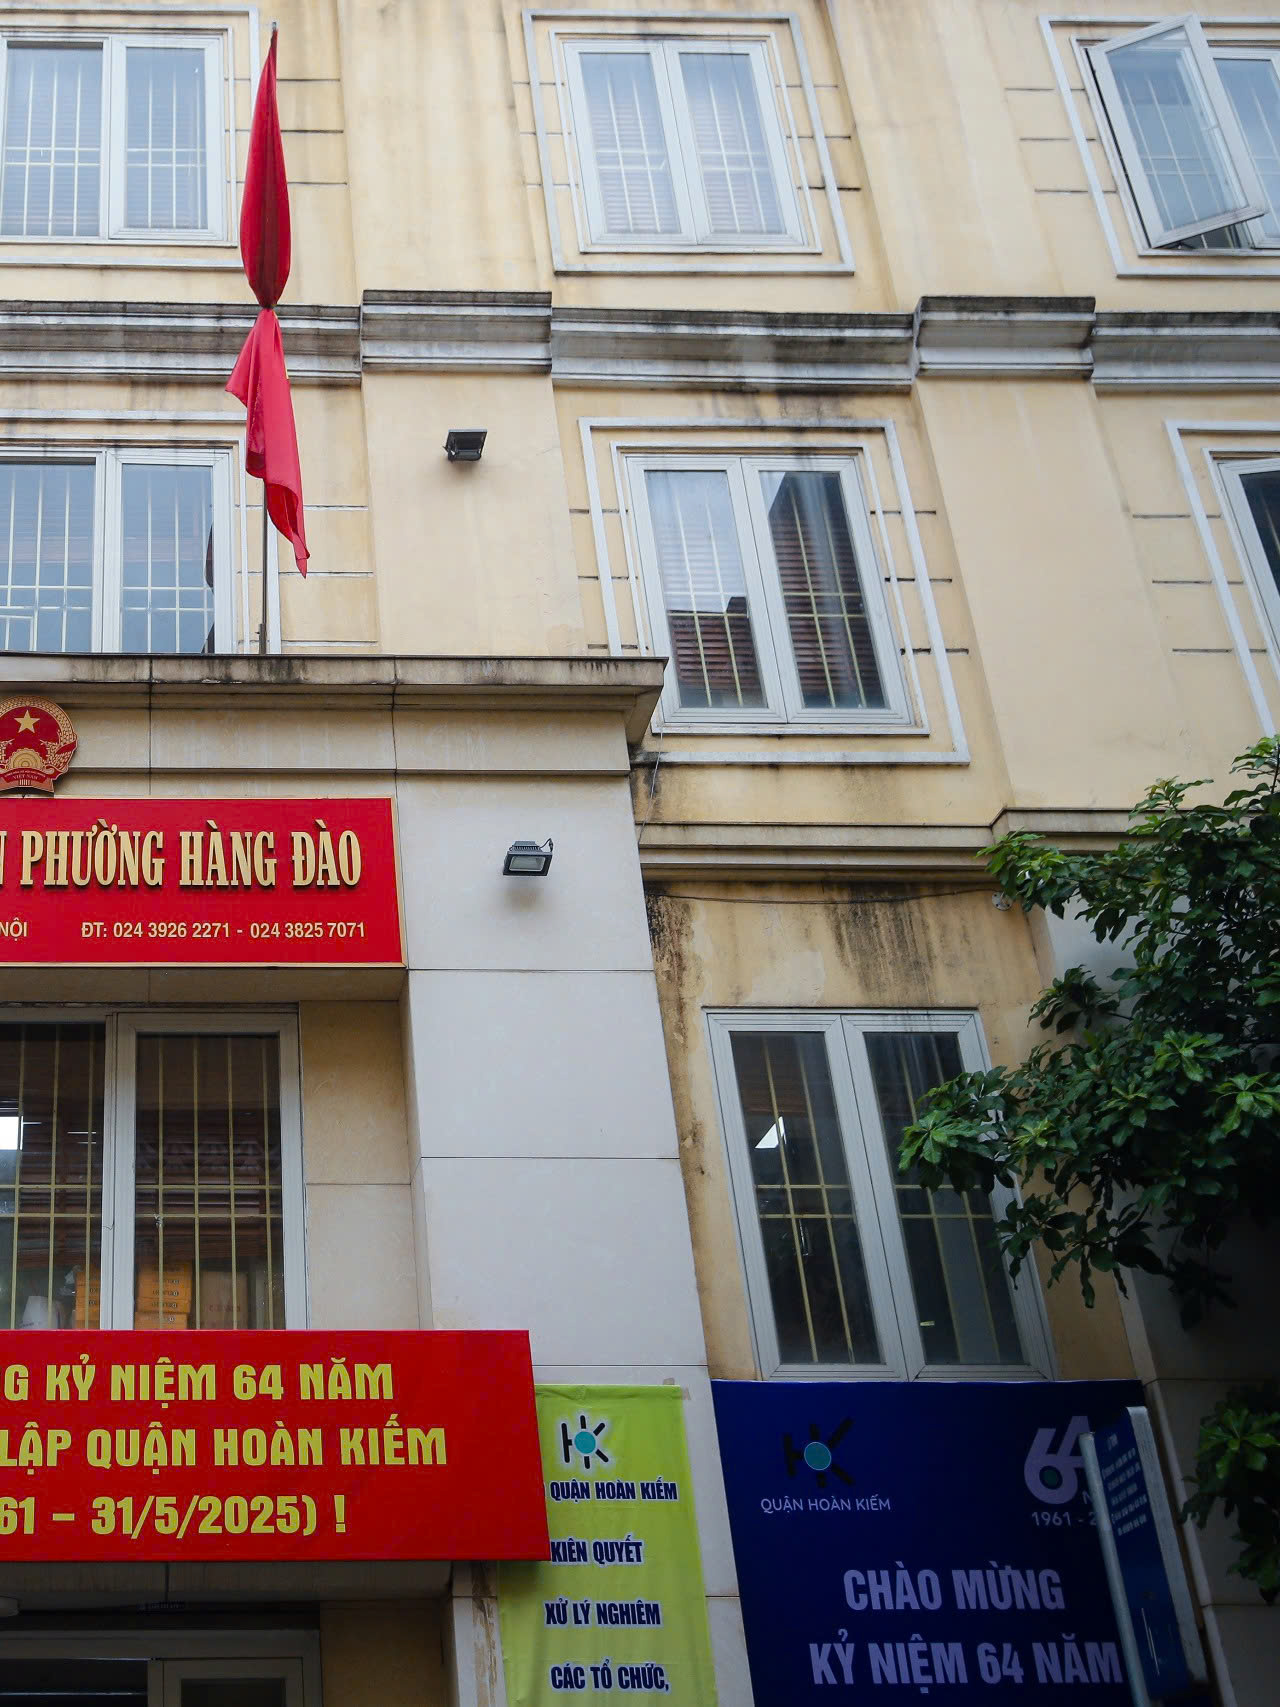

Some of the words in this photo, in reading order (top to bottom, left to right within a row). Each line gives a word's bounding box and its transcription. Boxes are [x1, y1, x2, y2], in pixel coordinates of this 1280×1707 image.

[19, 818, 165, 887] PHƯỜNG
[178, 819, 278, 887] HÀNG
[291, 819, 363, 887] ĐÀO
[81, 921, 107, 938] ĐT:
[113, 922, 143, 938] 024
[147, 922, 187, 938] 3926
[192, 922, 231, 938] 2271
[250, 922, 280, 939] 024
[284, 922, 324, 938] 3825
[327, 921, 365, 938] 7071
[45, 1353, 96, 1401] KỶ
[110, 1356, 216, 1409] NIỆM
[233, 1363, 284, 1401] 64
[300, 1356, 393, 1401] NĂM
[86, 1421, 196, 1475] QUẬN
[213, 1420, 323, 1466] HOÀN
[340, 1413, 448, 1466] KIẾM
[550, 1478, 590, 1503] QUẬN
[595, 1478, 636, 1500] HOÀN
[640, 1476, 678, 1500] KIẾM
[760, 1495, 804, 1514] QUẬN
[808, 1495, 851, 1511] HOÀN
[855, 1492, 891, 1511] KIẾM
[91, 1494, 318, 1540] 31/5/2025)
[333, 1494, 347, 1533] !
[1031, 1511, 1072, 1527] 1961
[550, 1537, 588, 1563] KIÊN
[593, 1534, 643, 1565] QUYẾT
[843, 1560, 941, 1611] CHÀO
[951, 1560, 1066, 1611] MỪNG
[544, 1597, 569, 1625] XỬ
[573, 1599, 591, 1625] LÝ
[596, 1599, 662, 1625] NGHIÊM
[550, 1661, 586, 1689] CÁC
[590, 1658, 613, 1689] TỔ
[617, 1662, 670, 1692] CHỨC,
[808, 1628, 856, 1685] KỶ
[868, 1633, 969, 1694] NIỆM
[976, 1641, 1024, 1685] 64
[1032, 1632, 1123, 1684] NĂM
